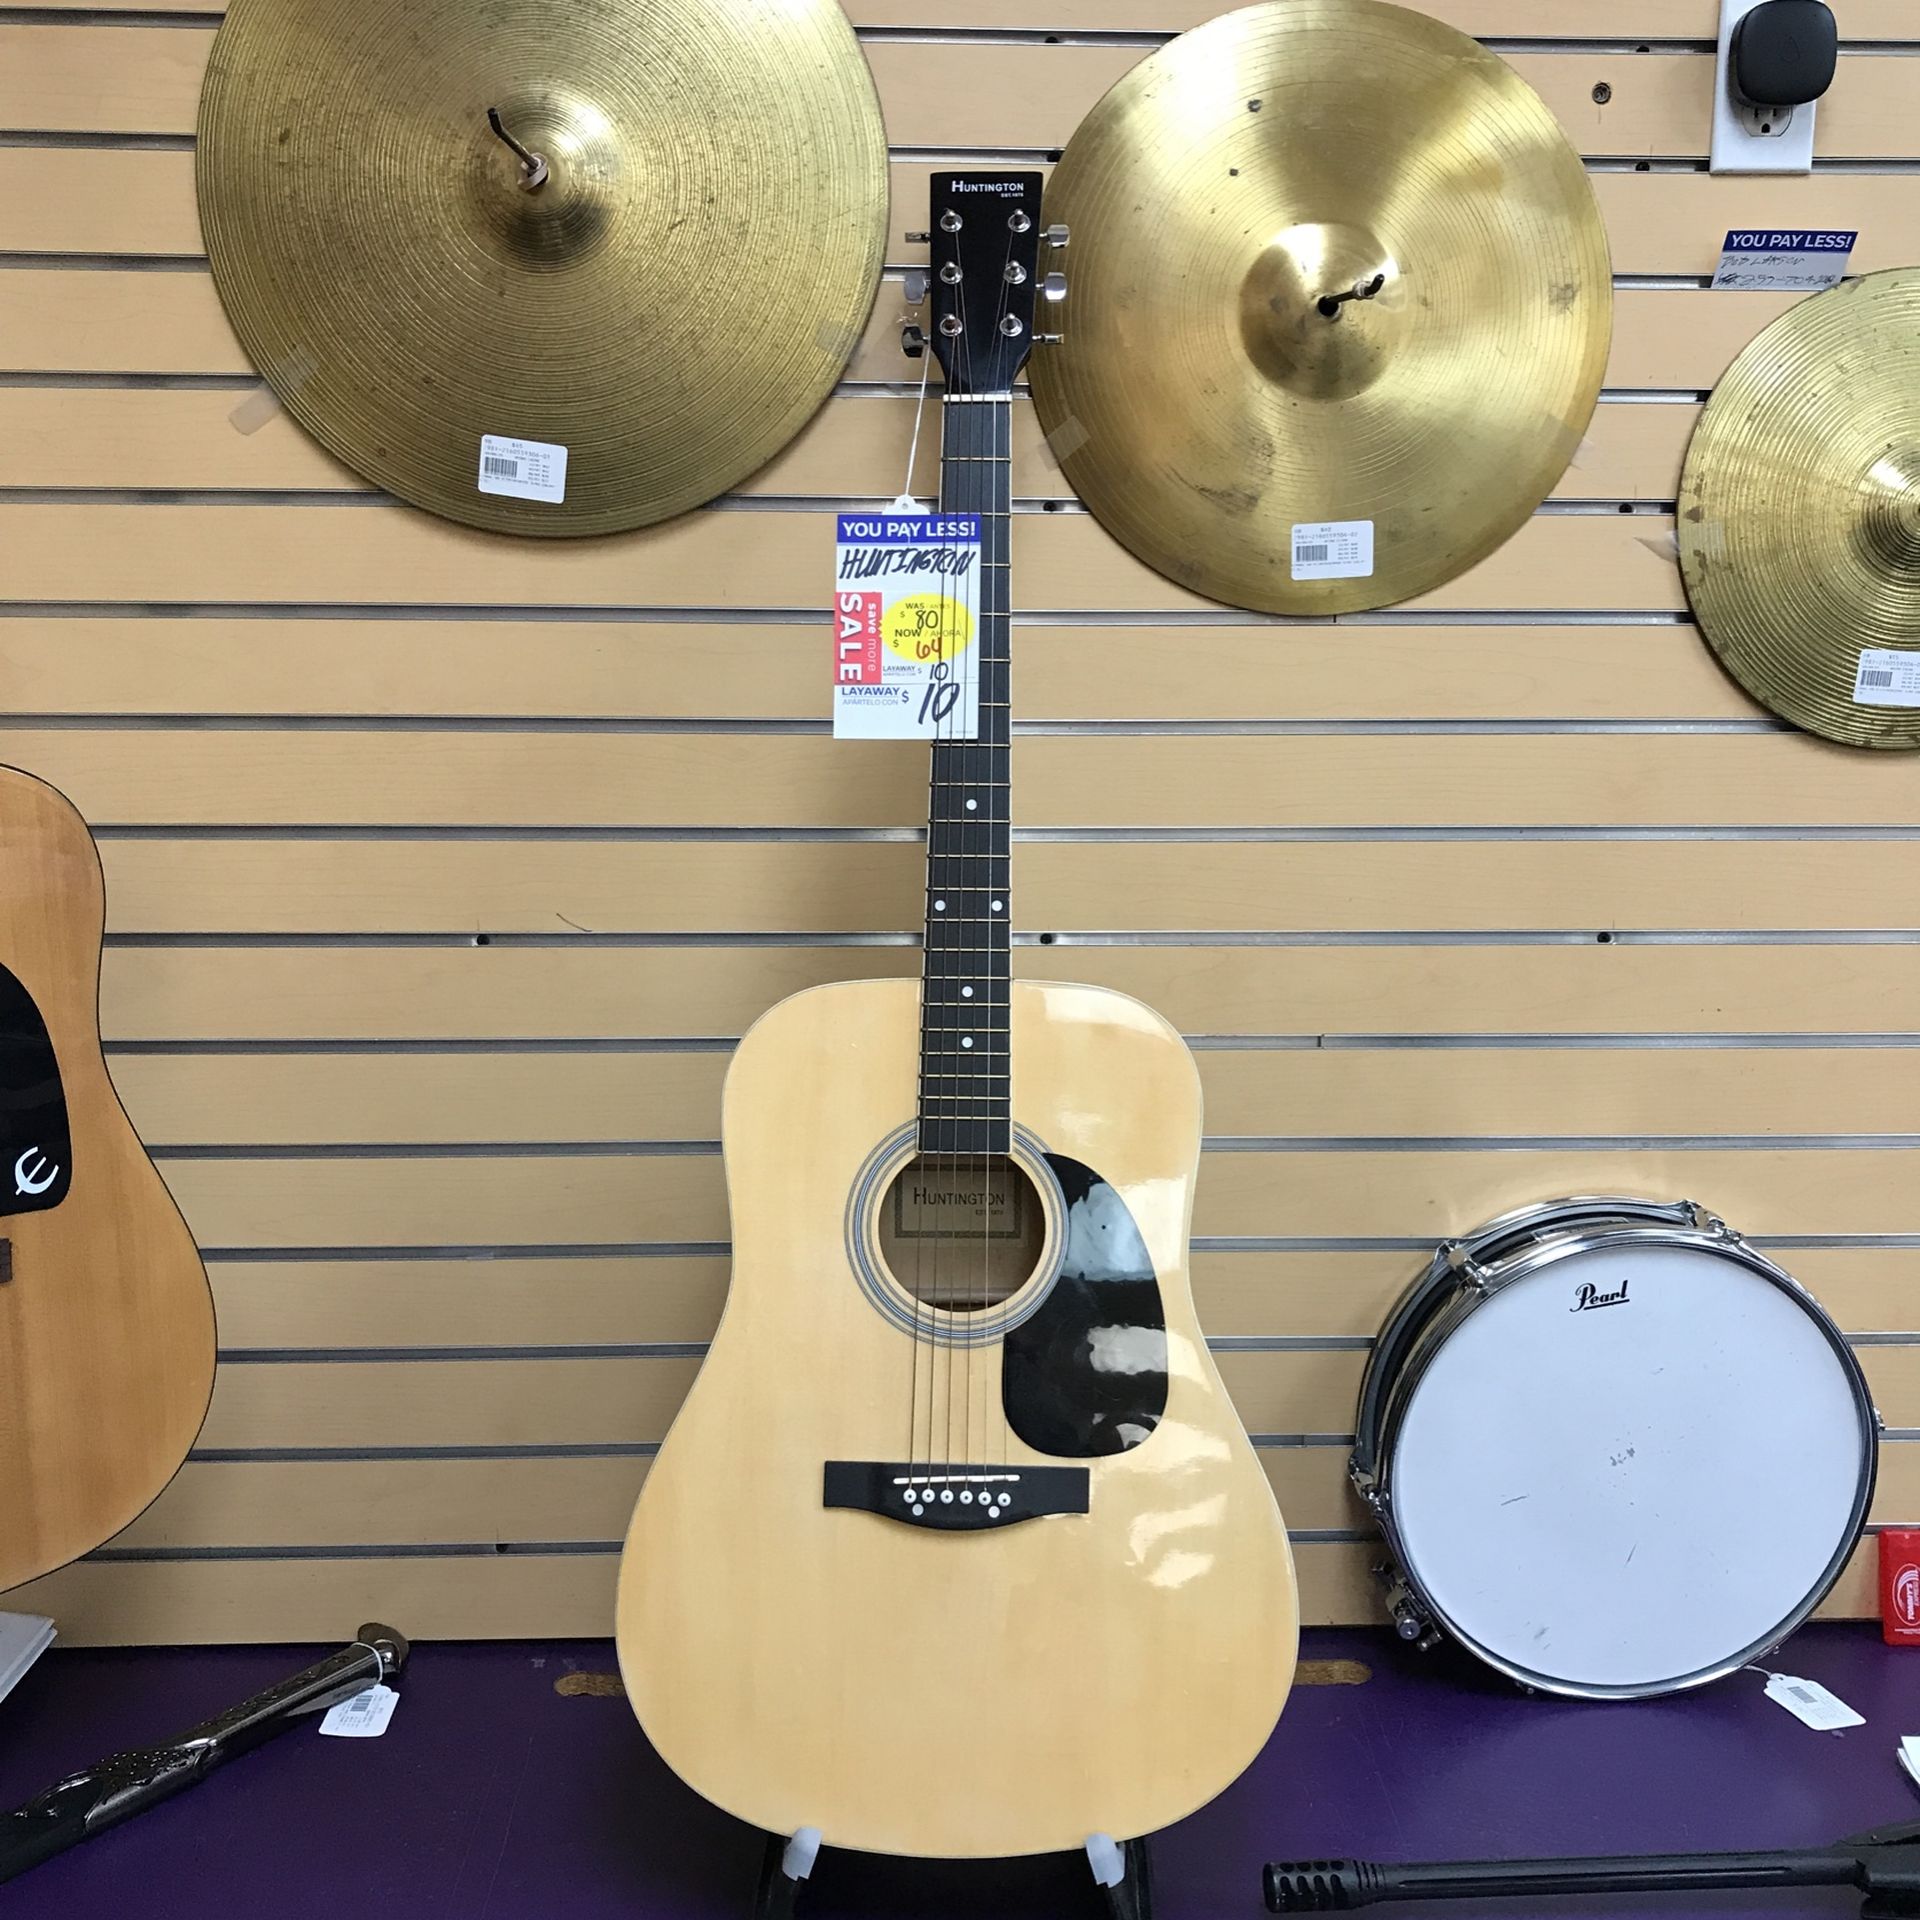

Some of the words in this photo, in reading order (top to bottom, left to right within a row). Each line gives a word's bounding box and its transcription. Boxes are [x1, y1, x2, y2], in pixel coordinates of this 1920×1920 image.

[951, 180, 1024, 192] HUNTINGTON
[1732, 234, 1767, 247] YOU
[1769, 234, 1803, 247] PAY
[1804, 235, 1852, 248] LESS!
[842, 522, 882, 537] YOU
[887, 522, 921, 537] PAY
[926, 521, 976, 536] LESS!
[868, 603, 877, 634] save
[915, 610, 939, 631] 80
[840, 593, 863, 681] SALE
[895, 629, 920, 637] NOW
[868, 638, 877, 672] more
[916, 636, 942, 659] 64
[929, 662, 949, 680] 10
[841, 687, 900, 696] LAYAWAY
[901, 690, 910, 704] $
[918, 683, 960, 725] 10
[914, 1187, 1005, 1205] HUNTINGTON
[1569, 1279, 1630, 1312] Pearl
